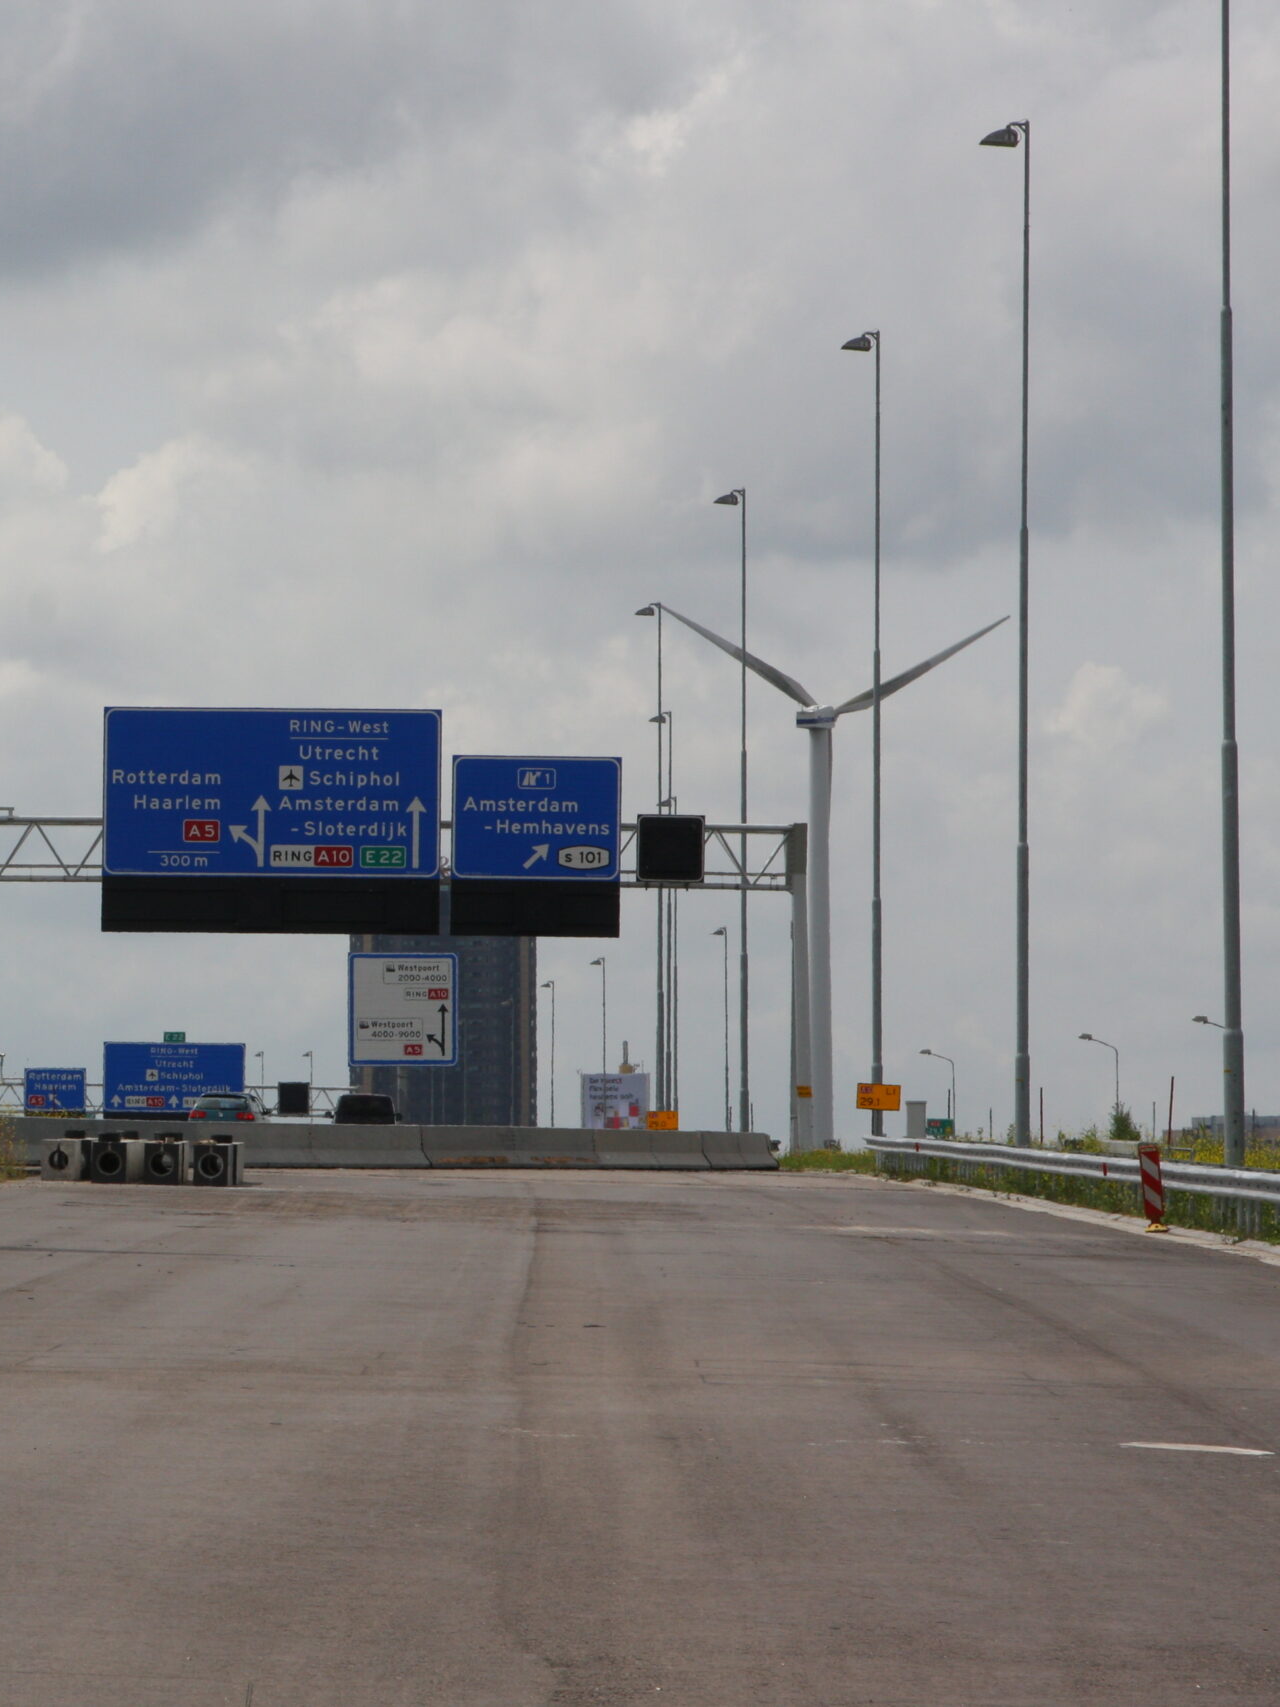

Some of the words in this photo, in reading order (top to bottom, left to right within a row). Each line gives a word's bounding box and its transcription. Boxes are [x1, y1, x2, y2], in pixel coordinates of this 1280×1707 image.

[290, 719, 389, 733] RING-West
[299, 745, 379, 761] Utrecht
[112, 769, 221, 785] Rotterdam
[309, 771, 400, 788] Schiphol
[545, 773, 550, 785] 1
[134, 795, 221, 810] Haarlem
[279, 796, 399, 811] Amsterdam
[463, 796, 578, 813] Amsterdam
[160, 854, 191, 867] 300
[194, 856, 208, 867] m
[273, 850, 313, 862] RING
[317, 850, 350, 863] A10
[579, 851, 601, 864] 101
[398, 974, 448, 982] 2000-4000
[430, 990, 447, 998] A10
